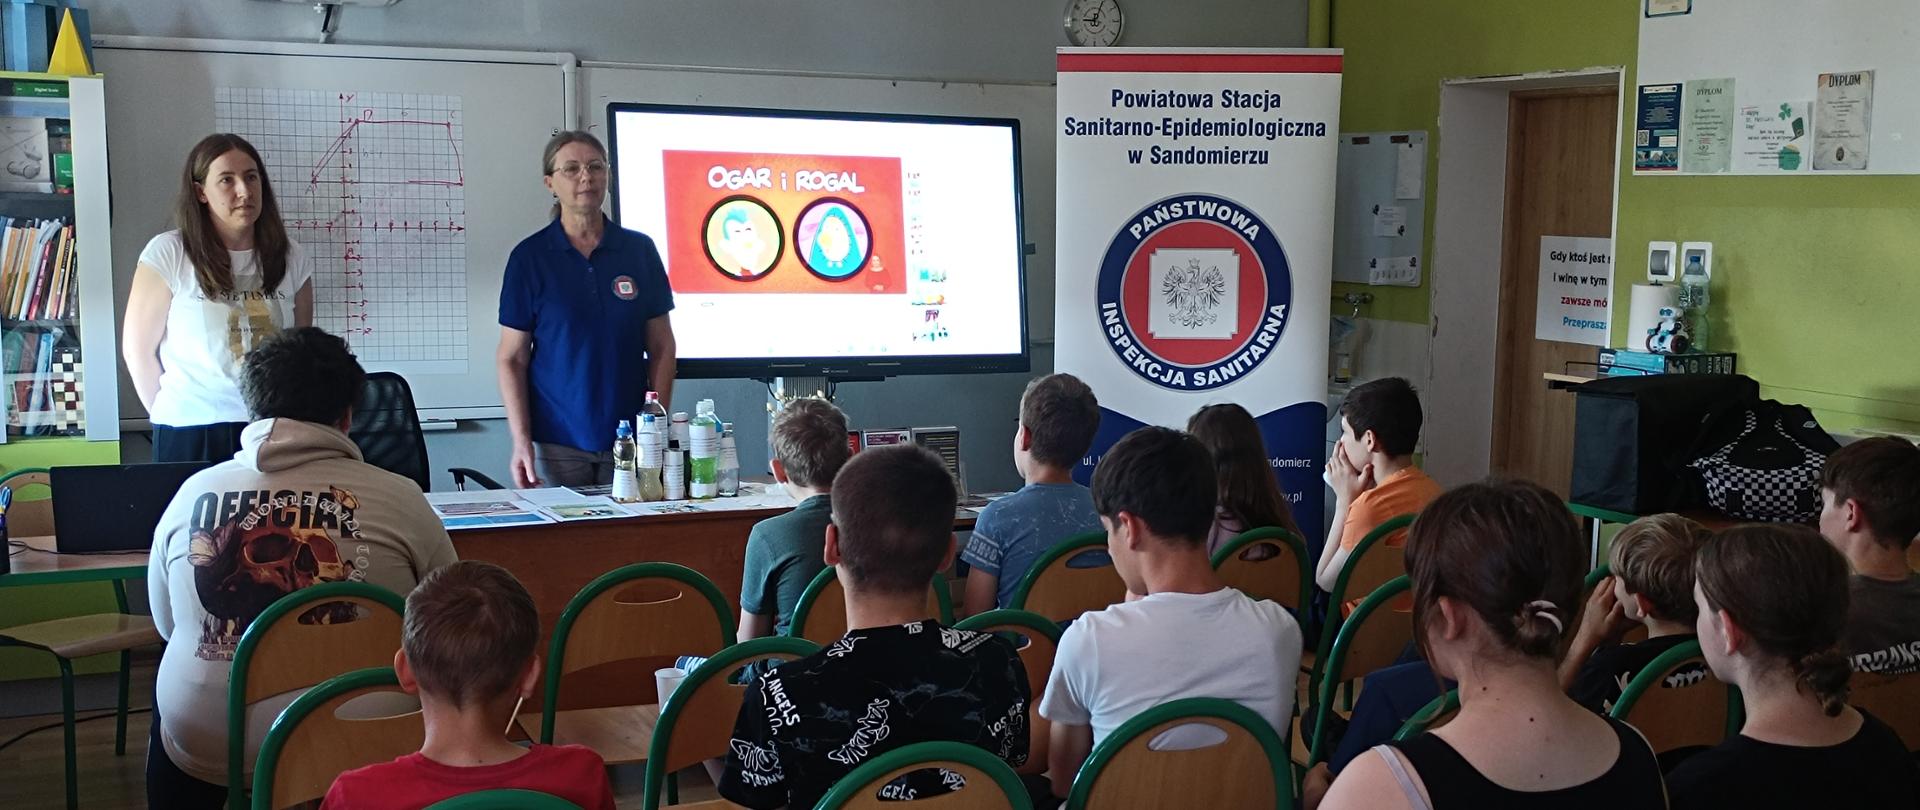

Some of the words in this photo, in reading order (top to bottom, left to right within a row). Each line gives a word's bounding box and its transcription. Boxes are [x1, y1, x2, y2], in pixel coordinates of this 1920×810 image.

[1696, 87, 1723, 95] DYPLOM
[1828, 74, 1861, 88] DYPLOM
[1111, 89, 1214, 108] Powiatowa
[1221, 89, 1281, 112] Stacja
[1064, 117, 1326, 140] Sanitarno-Epidemiologiczna
[1128, 149, 1143, 164] w
[1150, 145, 1269, 165] Sandomierzu
[707, 165, 772, 191] OGAR
[779, 171, 788, 192] i
[795, 170, 866, 194] ROGAL
[1129, 199, 1260, 241] PAŃSTWOWA
[1550, 251, 1567, 263] Gdy
[1569, 252, 1588, 263] ktoś
[1589, 253, 1606, 265] jest
[1553, 272, 1557, 282] I
[1558, 273, 1579, 286] winę
[1580, 277, 1589, 285] w
[1590, 275, 1608, 287] tym
[1560, 296, 1592, 306] zawsze
[1593, 298, 1608, 308] mó
[1102, 302, 1187, 387] INSPEKCJA
[1193, 302, 1286, 387] SANITARNA
[1083, 455, 1095, 466] ul.
[767, 678, 801, 726] ANGELS
[987, 716, 1007, 737] LOS
[880, 783, 918, 801] GELS
